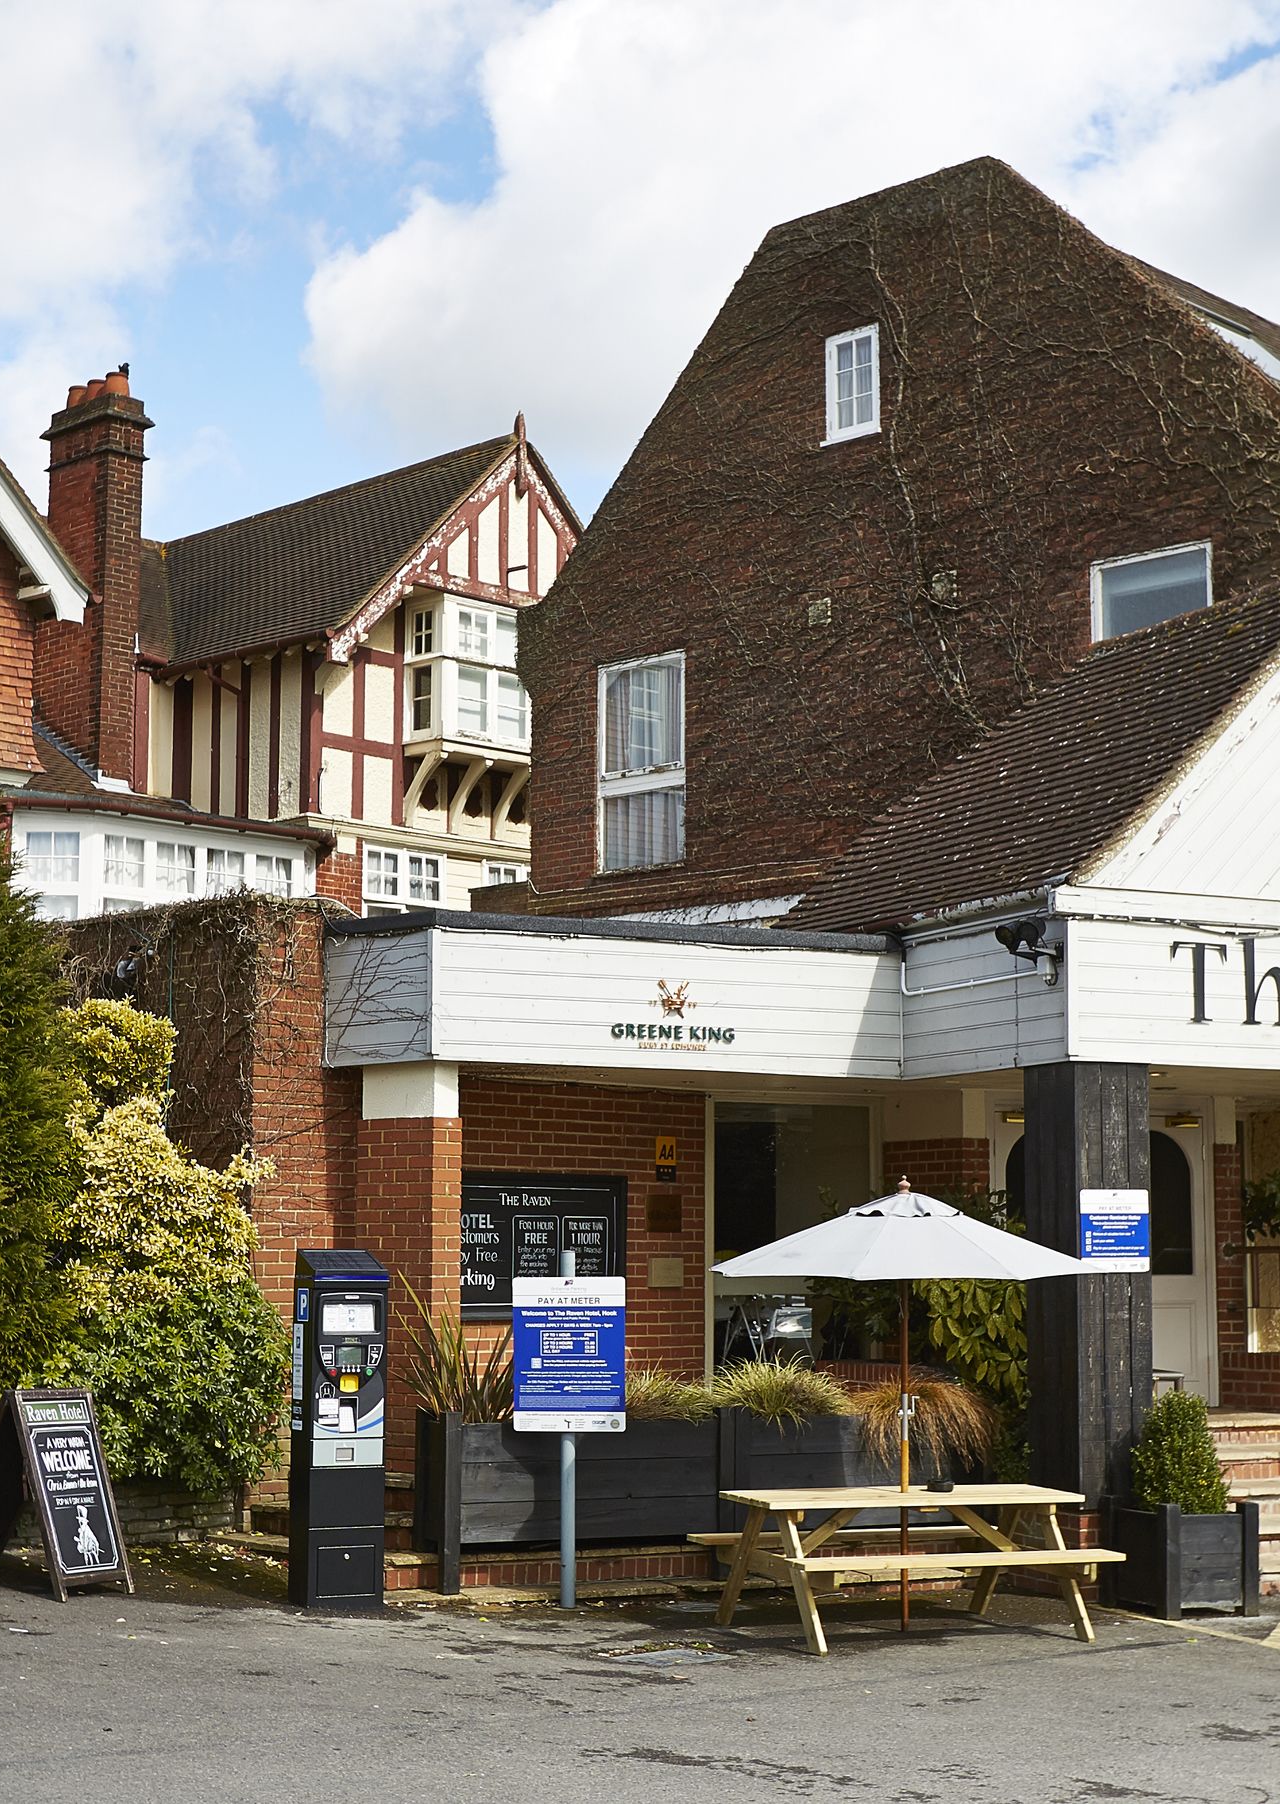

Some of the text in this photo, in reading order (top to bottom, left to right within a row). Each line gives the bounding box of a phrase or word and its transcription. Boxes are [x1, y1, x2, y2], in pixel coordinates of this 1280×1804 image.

[611, 1022, 735, 1044] GREENE KING
[658, 1144, 674, 1160] AA
[499, 1192, 552, 1207] THE RAVEN
[460, 1213, 495, 1229] OTEL
[524, 1232, 548, 1245] FREE
[578, 1232, 601, 1245] HOUR
[460, 1268, 496, 1290] rking
[300, 1294, 307, 1315] P
[26, 1403, 86, 1421] Raven Hotel
[46, 1437, 53, 1449] A
[52, 1437, 68, 1448] VERY
[40, 1449, 94, 1472] WELCOME
